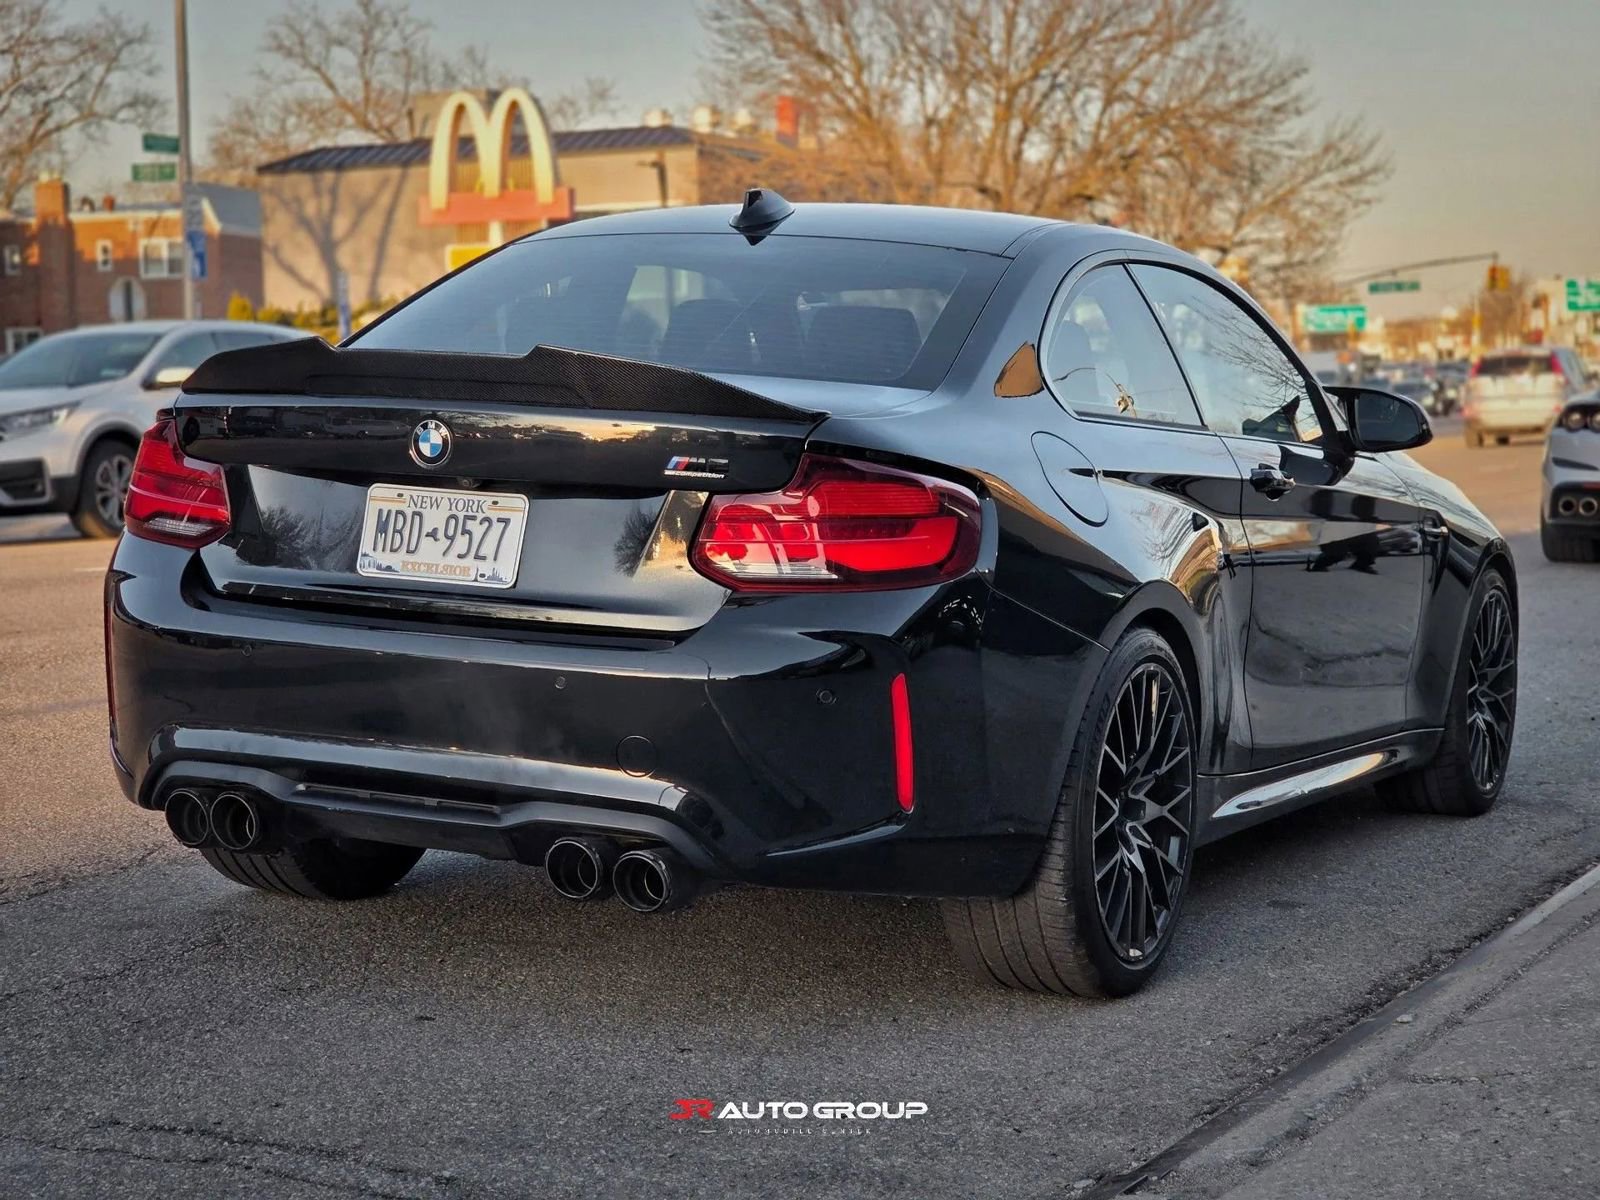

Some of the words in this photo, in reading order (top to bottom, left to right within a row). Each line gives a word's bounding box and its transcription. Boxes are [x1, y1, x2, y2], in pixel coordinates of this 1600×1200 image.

[407, 494, 445, 510] NEW
[446, 499, 488, 514] YORK
[401, 560, 471, 578] EXCELSIOR
